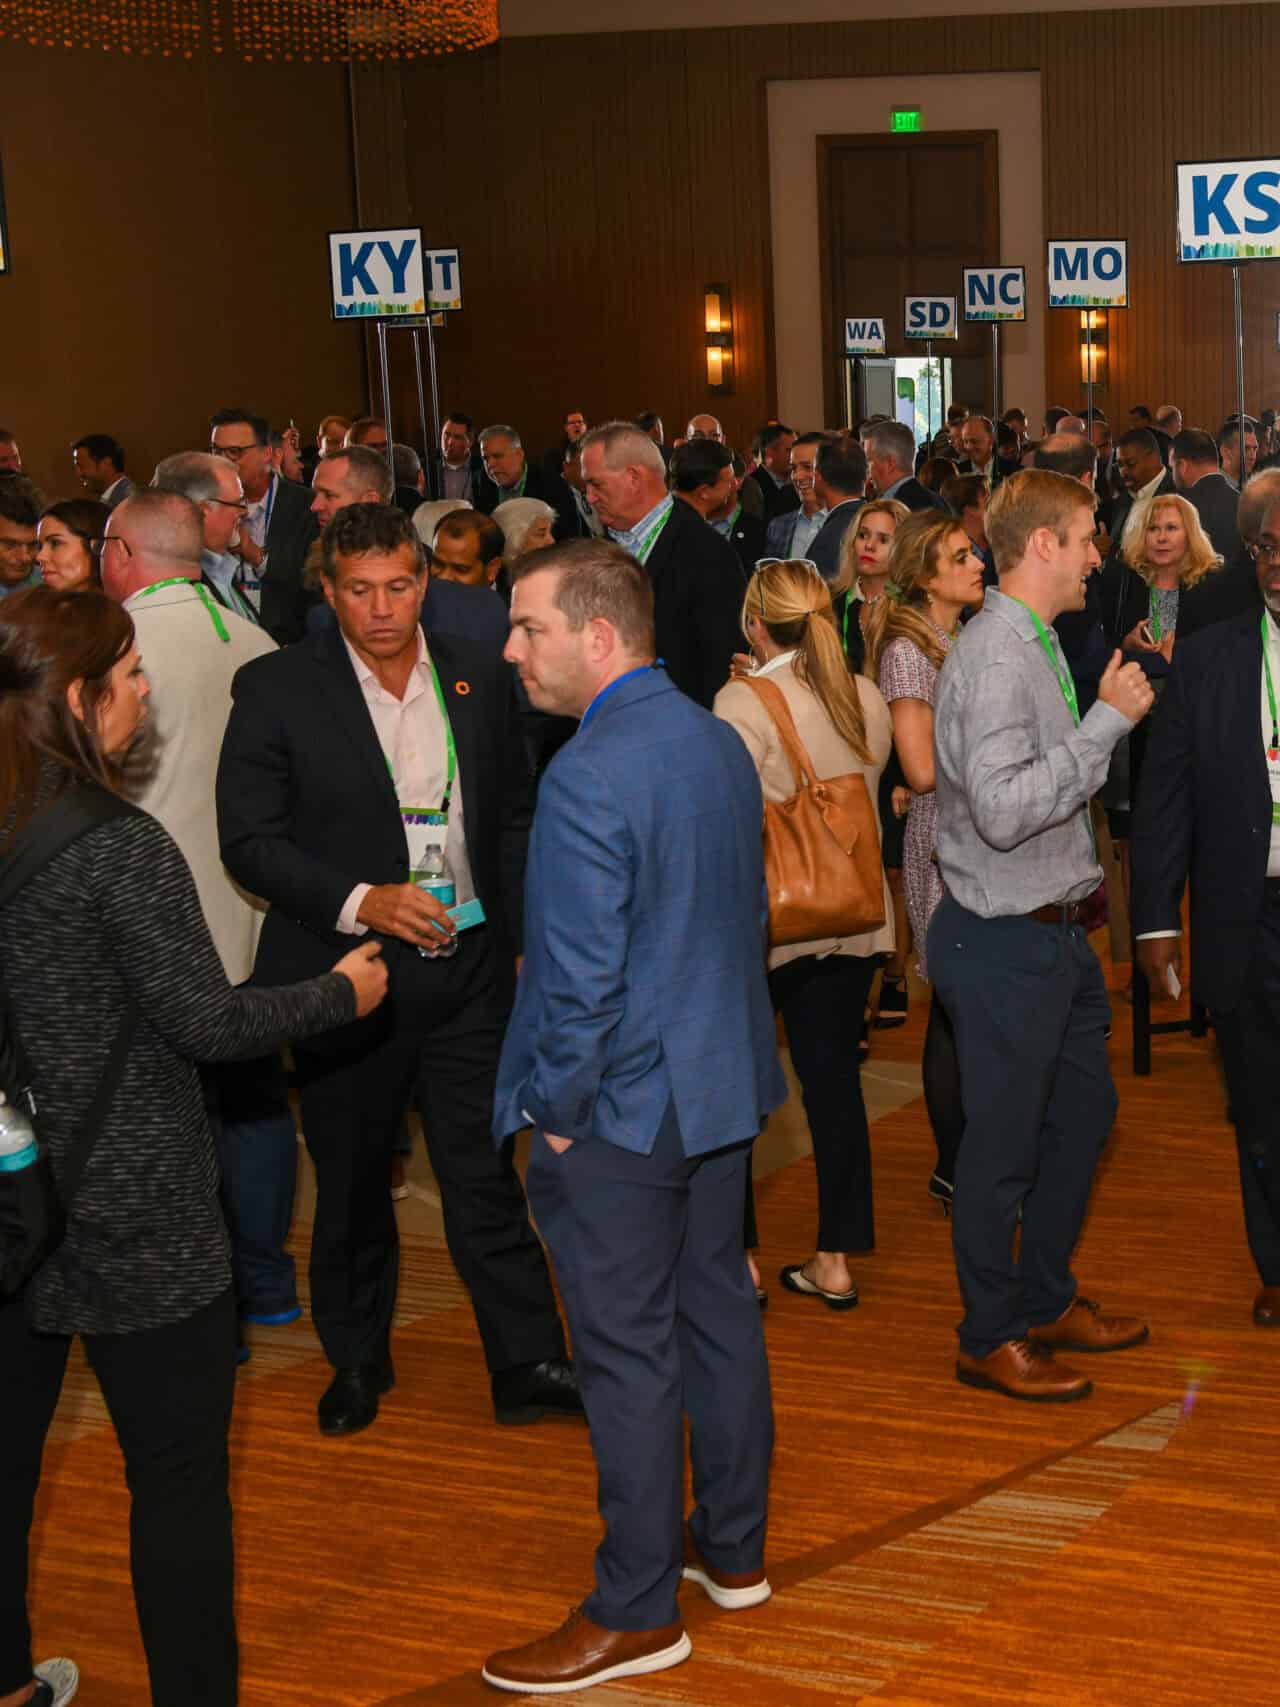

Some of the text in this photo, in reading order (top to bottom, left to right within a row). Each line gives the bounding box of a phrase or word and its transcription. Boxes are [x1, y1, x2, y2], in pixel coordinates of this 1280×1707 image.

[338, 239, 417, 297] KY
[1053, 246, 1122, 281] MO
[967, 272, 1021, 306] NC
[847, 321, 882, 340] WA
[909, 301, 951, 328] SD
